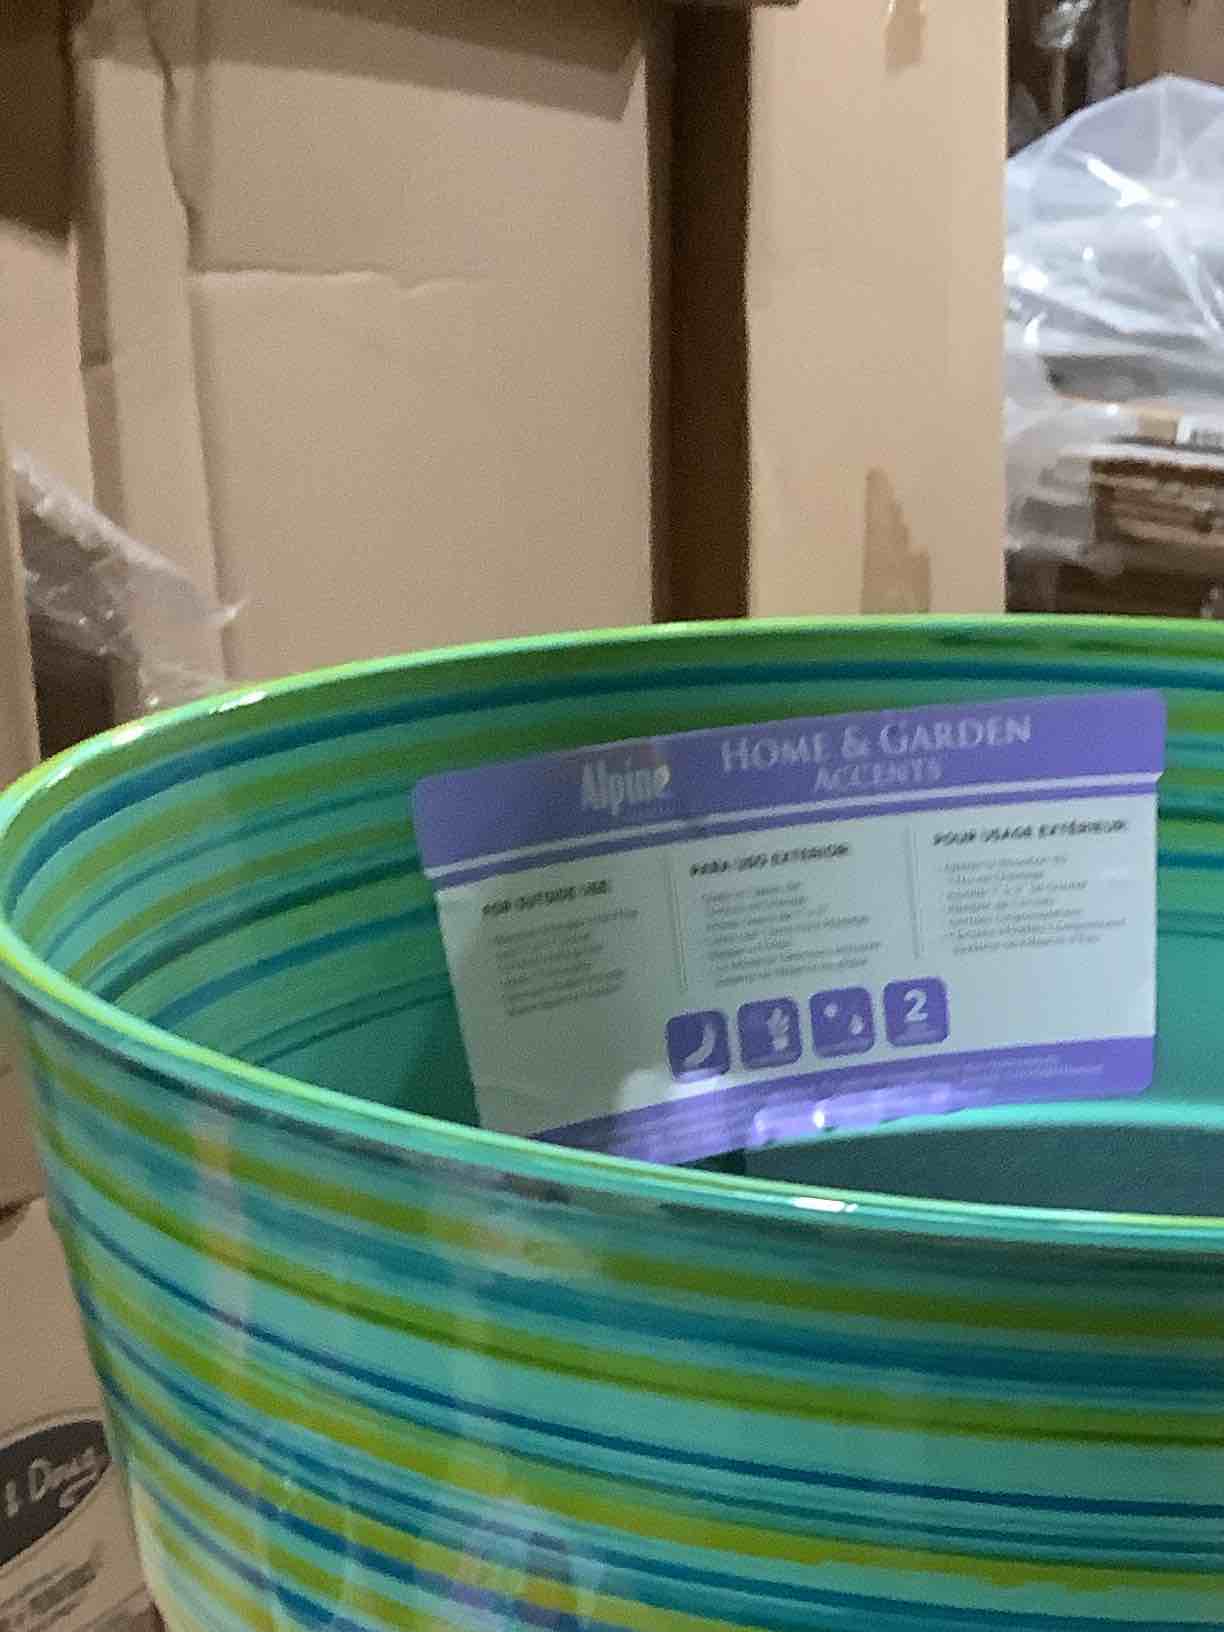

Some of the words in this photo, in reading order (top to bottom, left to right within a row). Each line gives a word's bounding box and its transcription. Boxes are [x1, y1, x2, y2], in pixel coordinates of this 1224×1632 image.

[720, 732, 830, 772] HOME
[840, 726, 869, 757] &
[880, 713, 1031, 755] GARDEN
[582, 757, 670, 815] Alpine
[815, 758, 943, 793] ACCENTS
[903, 988, 930, 1022] 2
